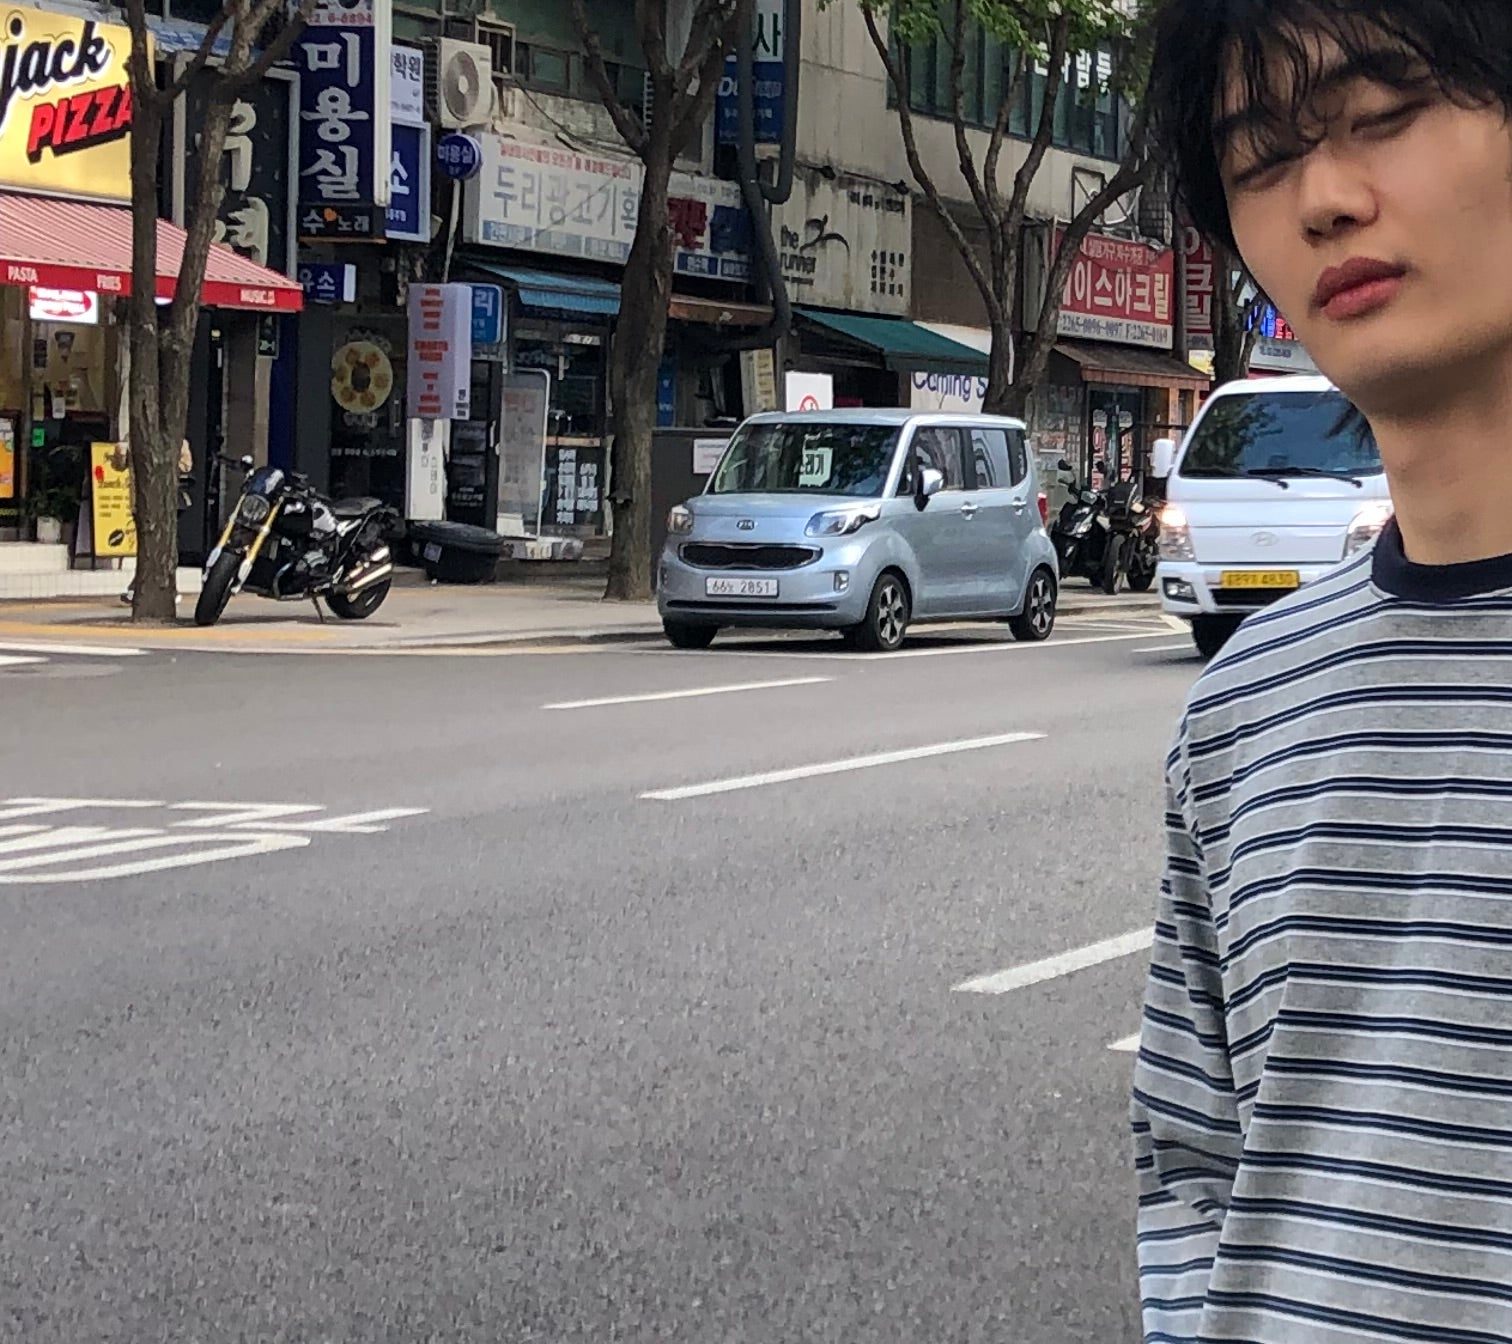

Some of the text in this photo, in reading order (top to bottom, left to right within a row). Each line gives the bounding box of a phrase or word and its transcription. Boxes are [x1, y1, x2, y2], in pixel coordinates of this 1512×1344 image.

[0, 18, 111, 130] jack
[300, 32, 370, 200] 미용실
[7, 264, 39, 284] PASTA
[1062, 259, 1170, 321] 이스아크릴
